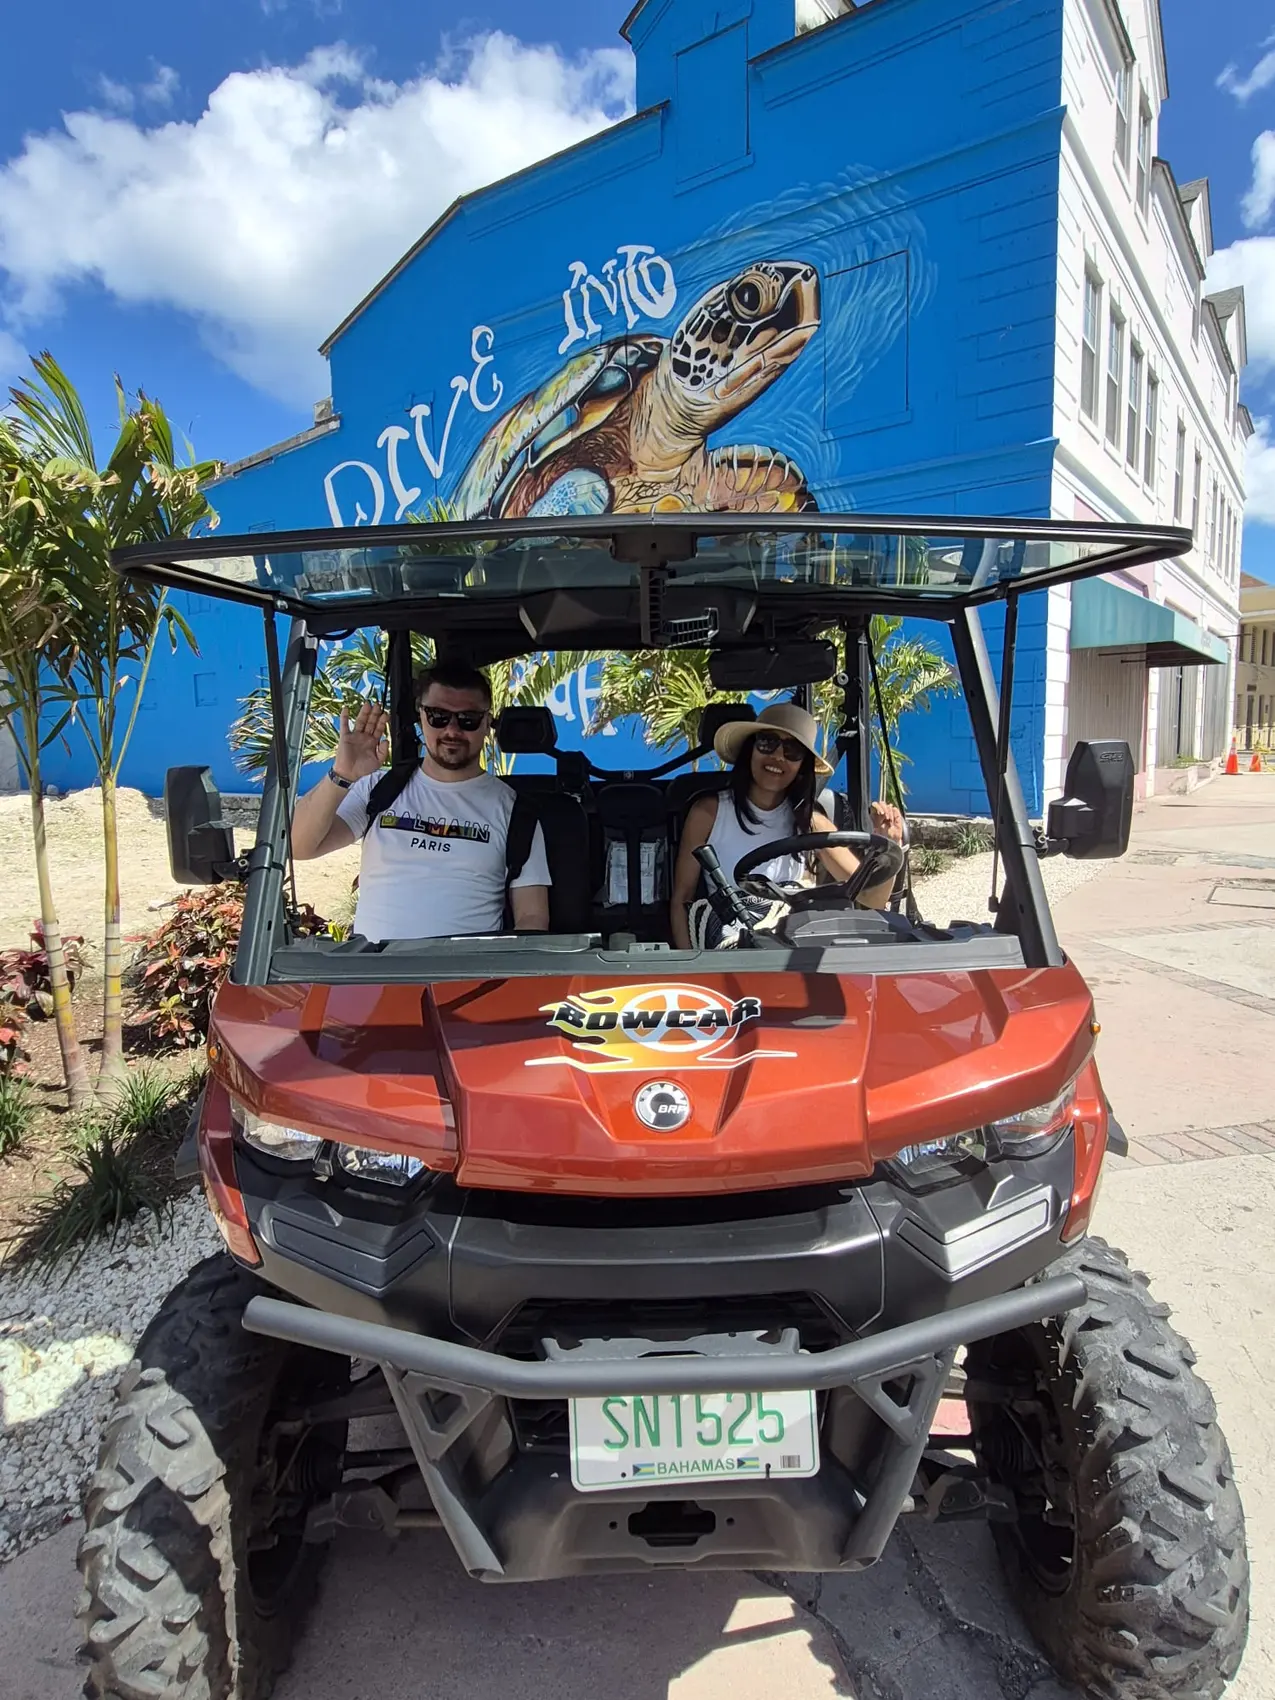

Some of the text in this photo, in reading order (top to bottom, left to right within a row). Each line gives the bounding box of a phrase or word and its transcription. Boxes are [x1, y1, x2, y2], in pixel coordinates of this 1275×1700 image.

[558, 245, 677, 354] INTO
[411, 838, 451, 852] PARIS
[553, 998, 760, 1030] BOWCAR
[658, 1104, 687, 1114] BRP
[602, 1392, 785, 1449] SN1525
[657, 1459, 735, 1475] BAHAMAS
